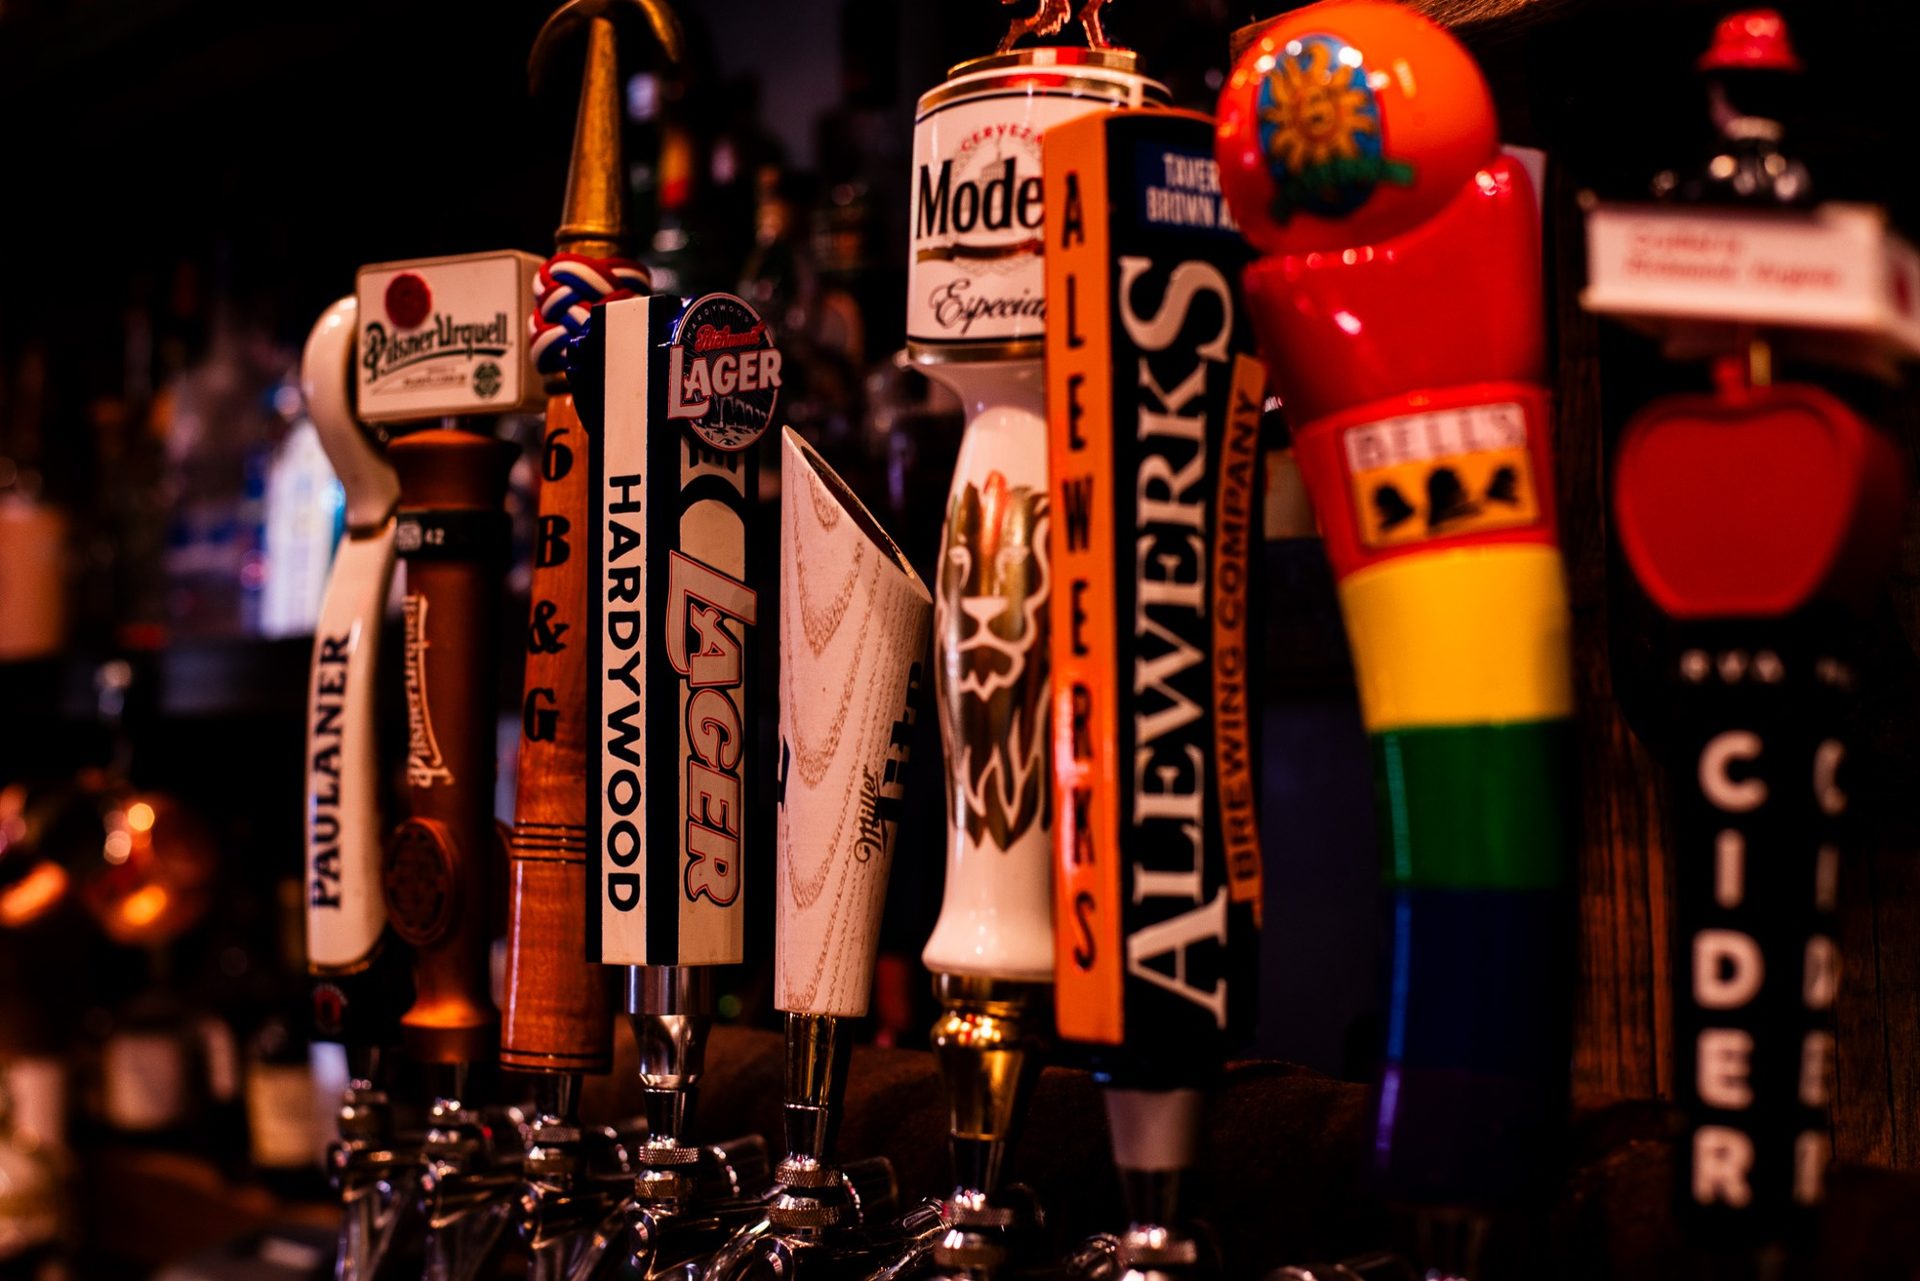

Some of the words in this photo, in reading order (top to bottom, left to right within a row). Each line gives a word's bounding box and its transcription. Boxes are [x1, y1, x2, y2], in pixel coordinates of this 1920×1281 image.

[916, 156, 1045, 241] Mode
[1146, 186, 1215, 229] BROWN
[1162, 152, 1221, 194] TAVER
[364, 322, 435, 384] Pilsner
[434, 313, 508, 360] Urquell
[668, 344, 783, 420] LAGER
[929, 278, 1047, 336] Especia
[1061, 169, 1097, 972] ALEWERKS
[1216, 388, 1260, 629] COMPANY
[606, 473, 642, 912] HARDYWOOD
[665, 549, 758, 908] LAGER
[1117, 255, 1234, 1030] ALEWERKS
[310, 631, 351, 911] PAULANER
[854, 765, 883, 864] Miller
[1217, 645, 1257, 884] BREWING
[1691, 729, 1769, 1208] CIDER
